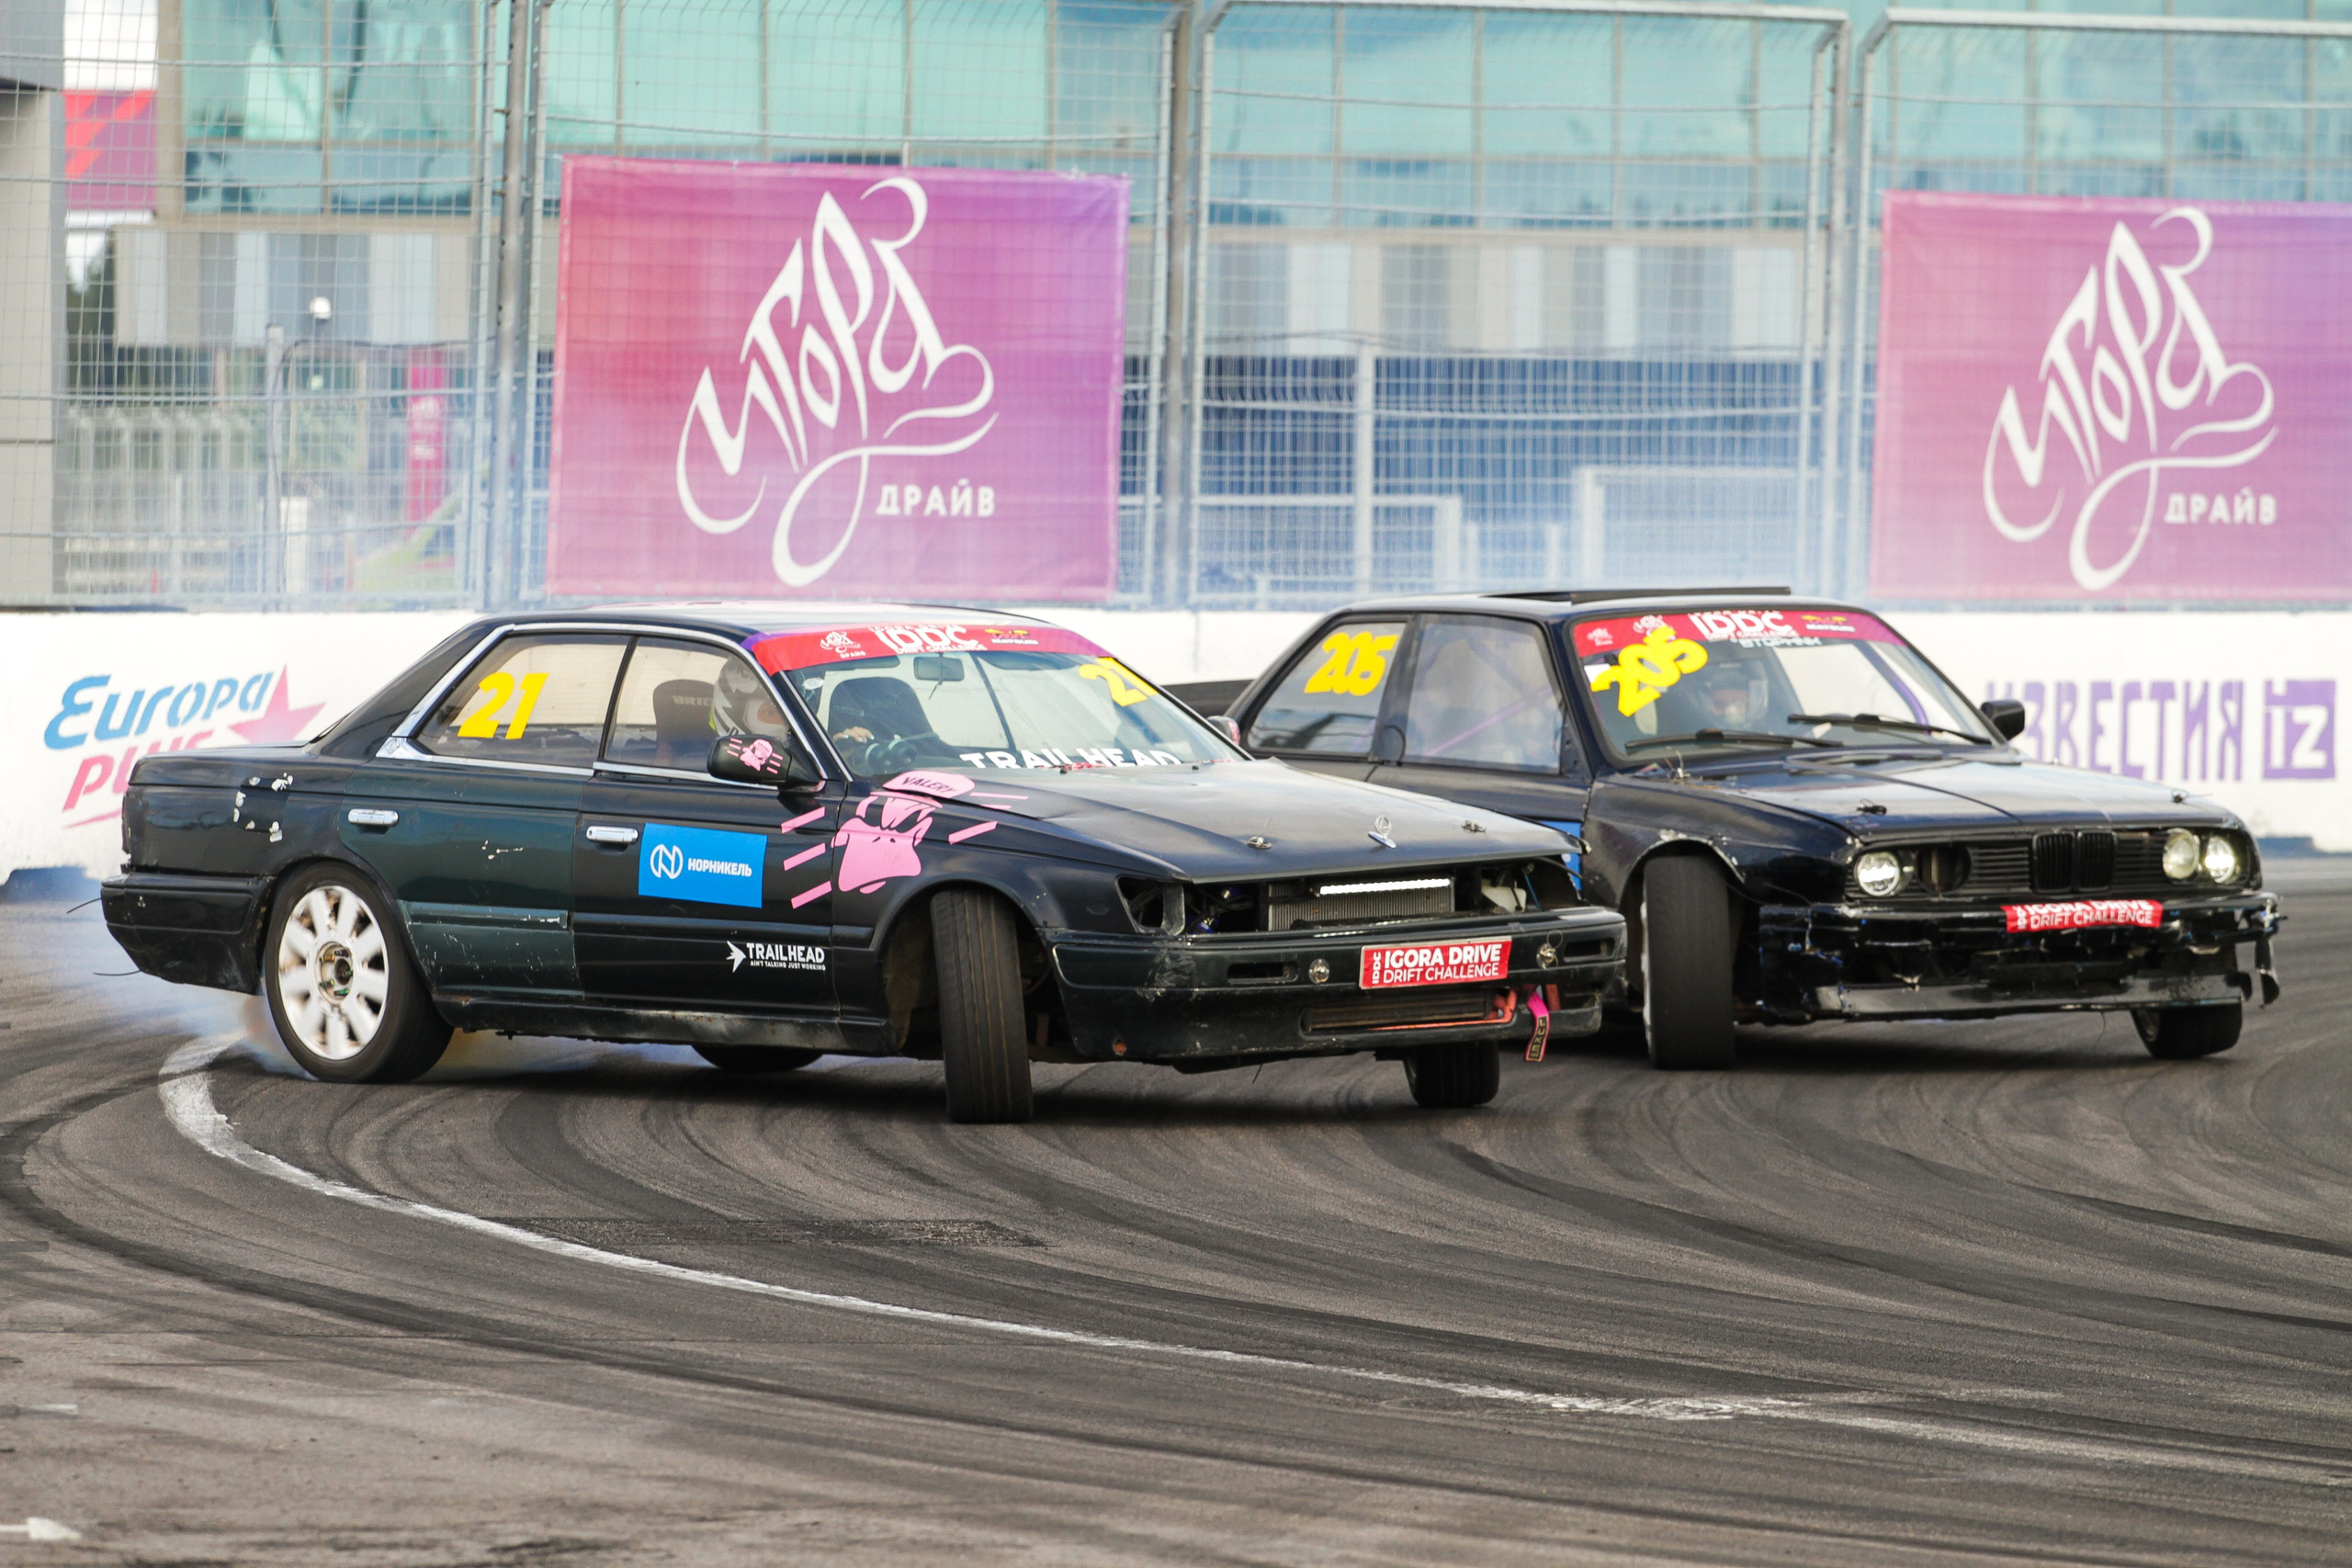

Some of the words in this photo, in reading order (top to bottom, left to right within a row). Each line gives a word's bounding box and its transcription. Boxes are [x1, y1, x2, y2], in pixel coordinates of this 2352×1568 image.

[876, 478, 997, 517] ДРАЙВ
[2163, 487, 2278, 525] ДРАЙВ
[1689, 613, 1792, 637] IDDC
[874, 626, 978, 651] IDDC
[1304, 631, 1398, 696] 205
[1590, 625, 1709, 717] 205
[458, 671, 549, 739] 21
[1986, 680, 2245, 781] ЗВЕСТИЯ
[901, 776, 958, 794] VALERY
[687, 857, 752, 877] НОРНИКЕЛЬ
[2030, 911, 2071, 930] DRIFT
[2073, 909, 2153, 926] CHALLENGE
[746, 942, 825, 964] TRAILHEAD
[1385, 948, 1444, 968] IGORA
[1448, 943, 1502, 964] DRIVE
[764, 960, 786, 969] TALKING
[787, 962, 801, 970] JUST
[801, 963, 826, 972] WORKING
[1372, 952, 1382, 985] IDDC
[1383, 966, 1423, 984] DRIFT
[1424, 962, 1499, 981] CHALLENGE
